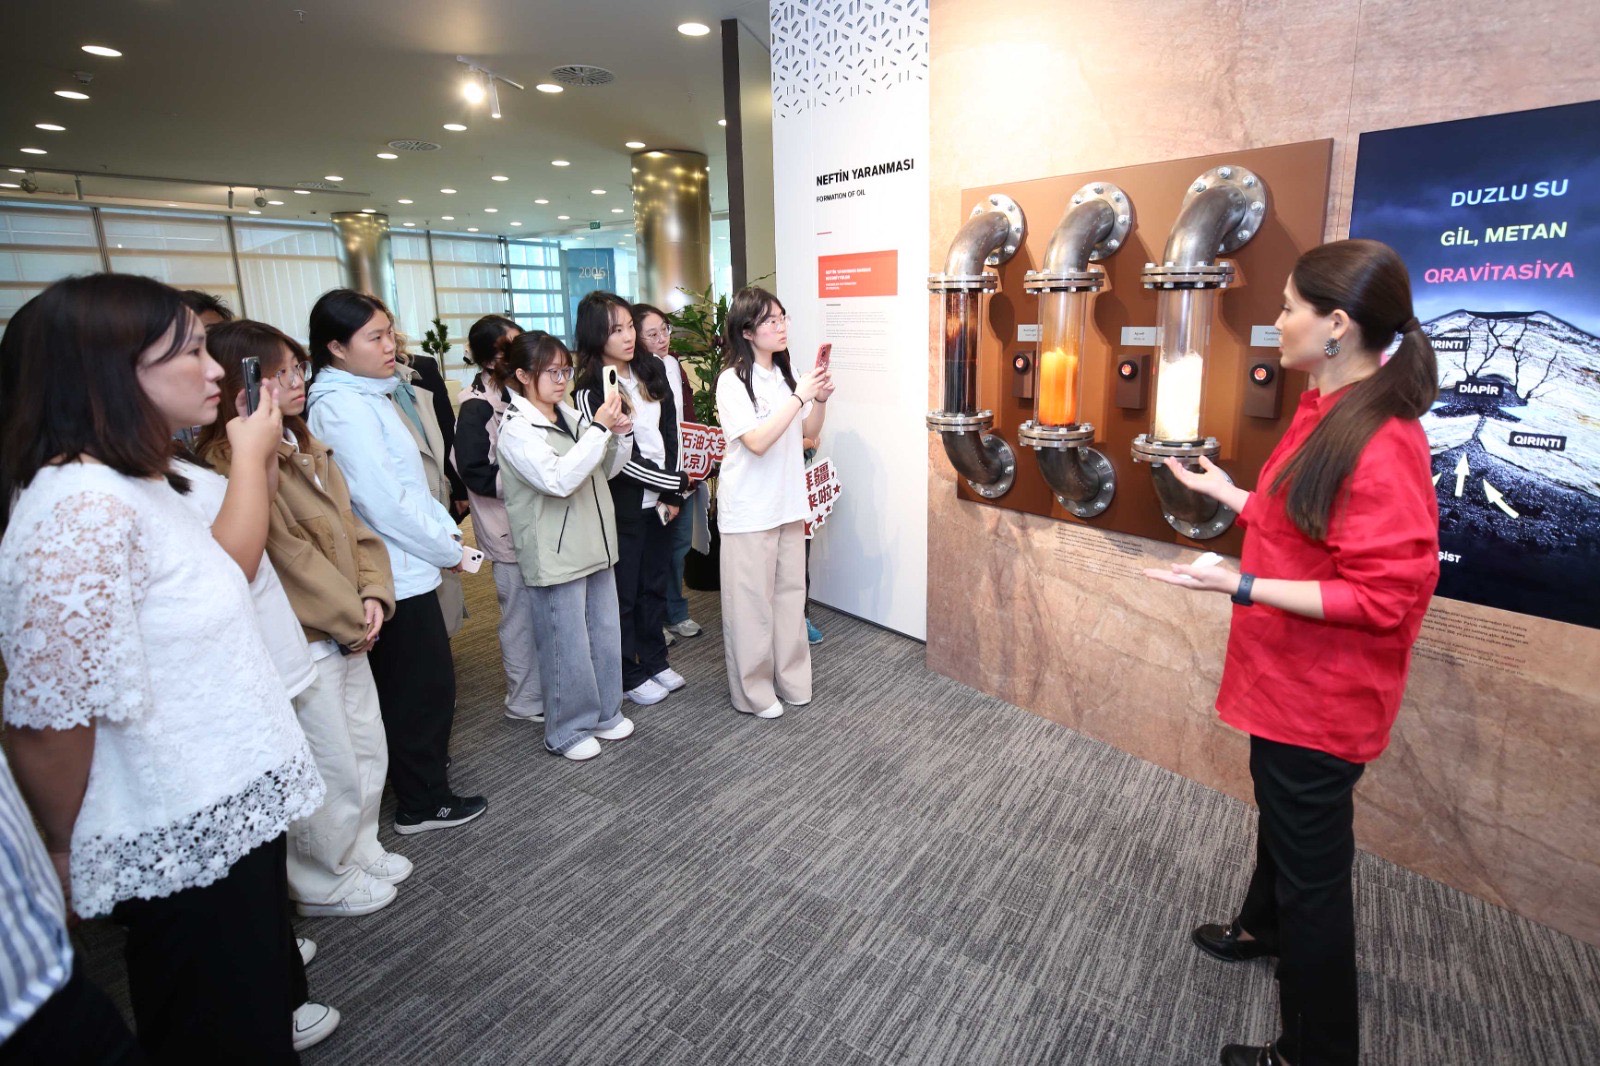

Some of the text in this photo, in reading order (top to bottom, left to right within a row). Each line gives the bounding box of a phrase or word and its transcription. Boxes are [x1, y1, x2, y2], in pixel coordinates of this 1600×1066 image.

[816, 158, 914, 186] NEFTİN YARANMASI
[816, 188, 866, 202] FORMATION OF OIL
[1450, 179, 1569, 207] DUZLU SU
[1440, 221, 1568, 247] GİL, METAN
[1424, 259, 1576, 284] QRAVİTASİYA
[1431, 339, 1464, 350] IRINTI
[1458, 382, 1499, 395] DİAPİR
[682, 431, 727, 453] 石油大学
[1513, 435, 1561, 448] QIRINTI
[436, 806, 452, 818] N
